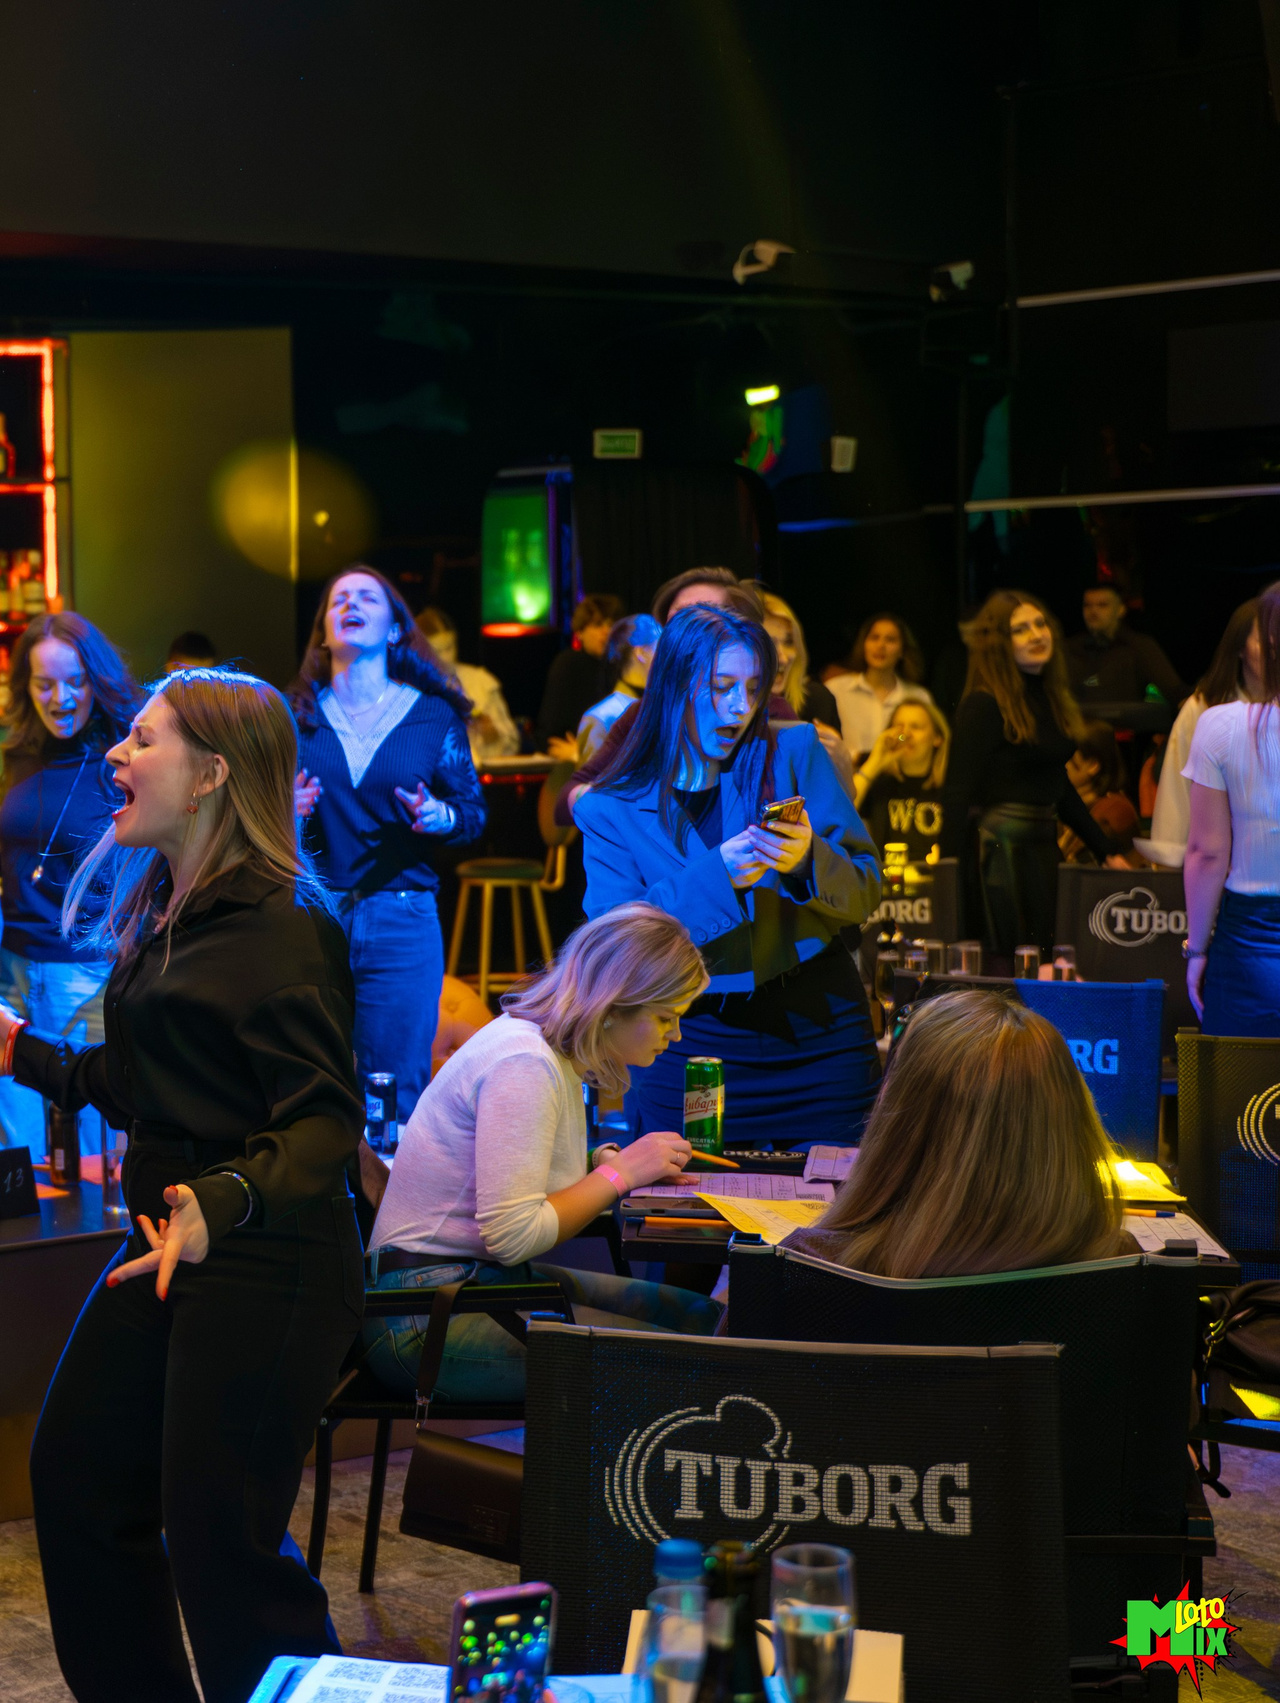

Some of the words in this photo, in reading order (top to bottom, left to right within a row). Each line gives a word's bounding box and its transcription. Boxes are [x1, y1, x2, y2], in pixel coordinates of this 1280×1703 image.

[1111, 907, 1189, 934] TUBO
[3, 1168, 24, 1193] 13
[664, 1448, 972, 1536] TUBORG
